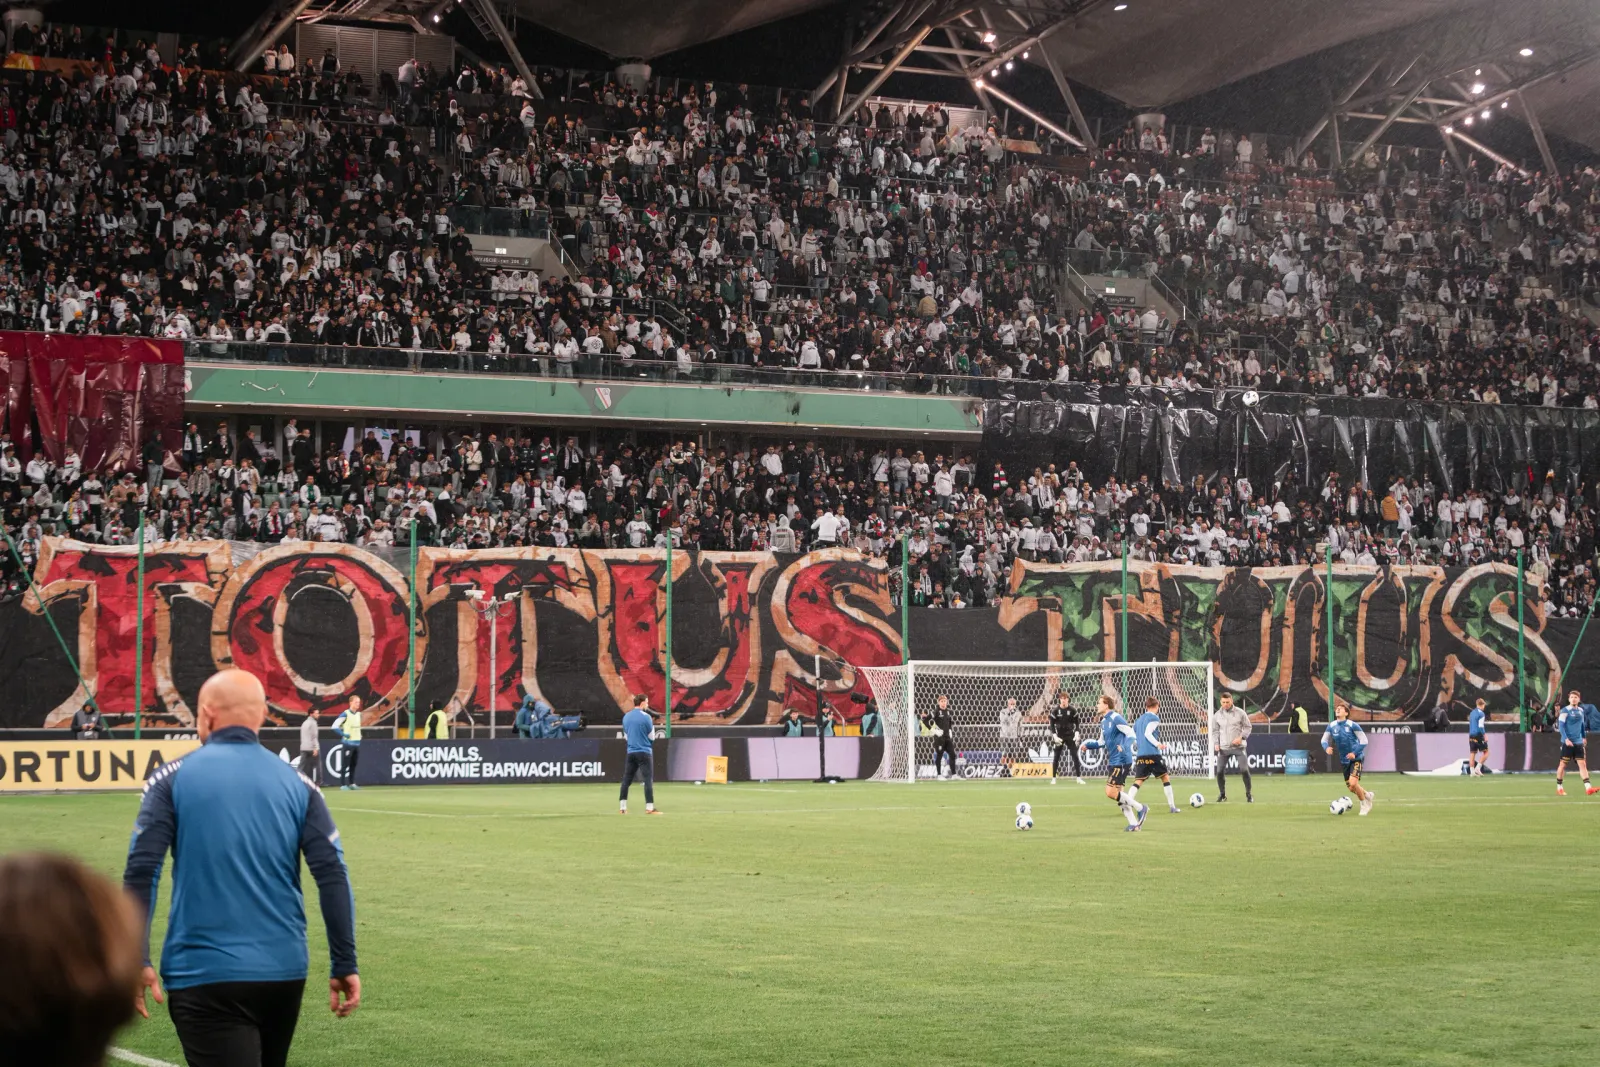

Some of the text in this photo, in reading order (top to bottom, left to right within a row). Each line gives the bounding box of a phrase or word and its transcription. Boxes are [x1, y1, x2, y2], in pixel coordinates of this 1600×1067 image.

[22, 534, 907, 728] TOTUS
[0, 750, 164, 782] RTUNA
[391, 746, 483, 762] ORIGINALS.
[391, 761, 605, 778] PONOWNIE BARWACH LEGII.
